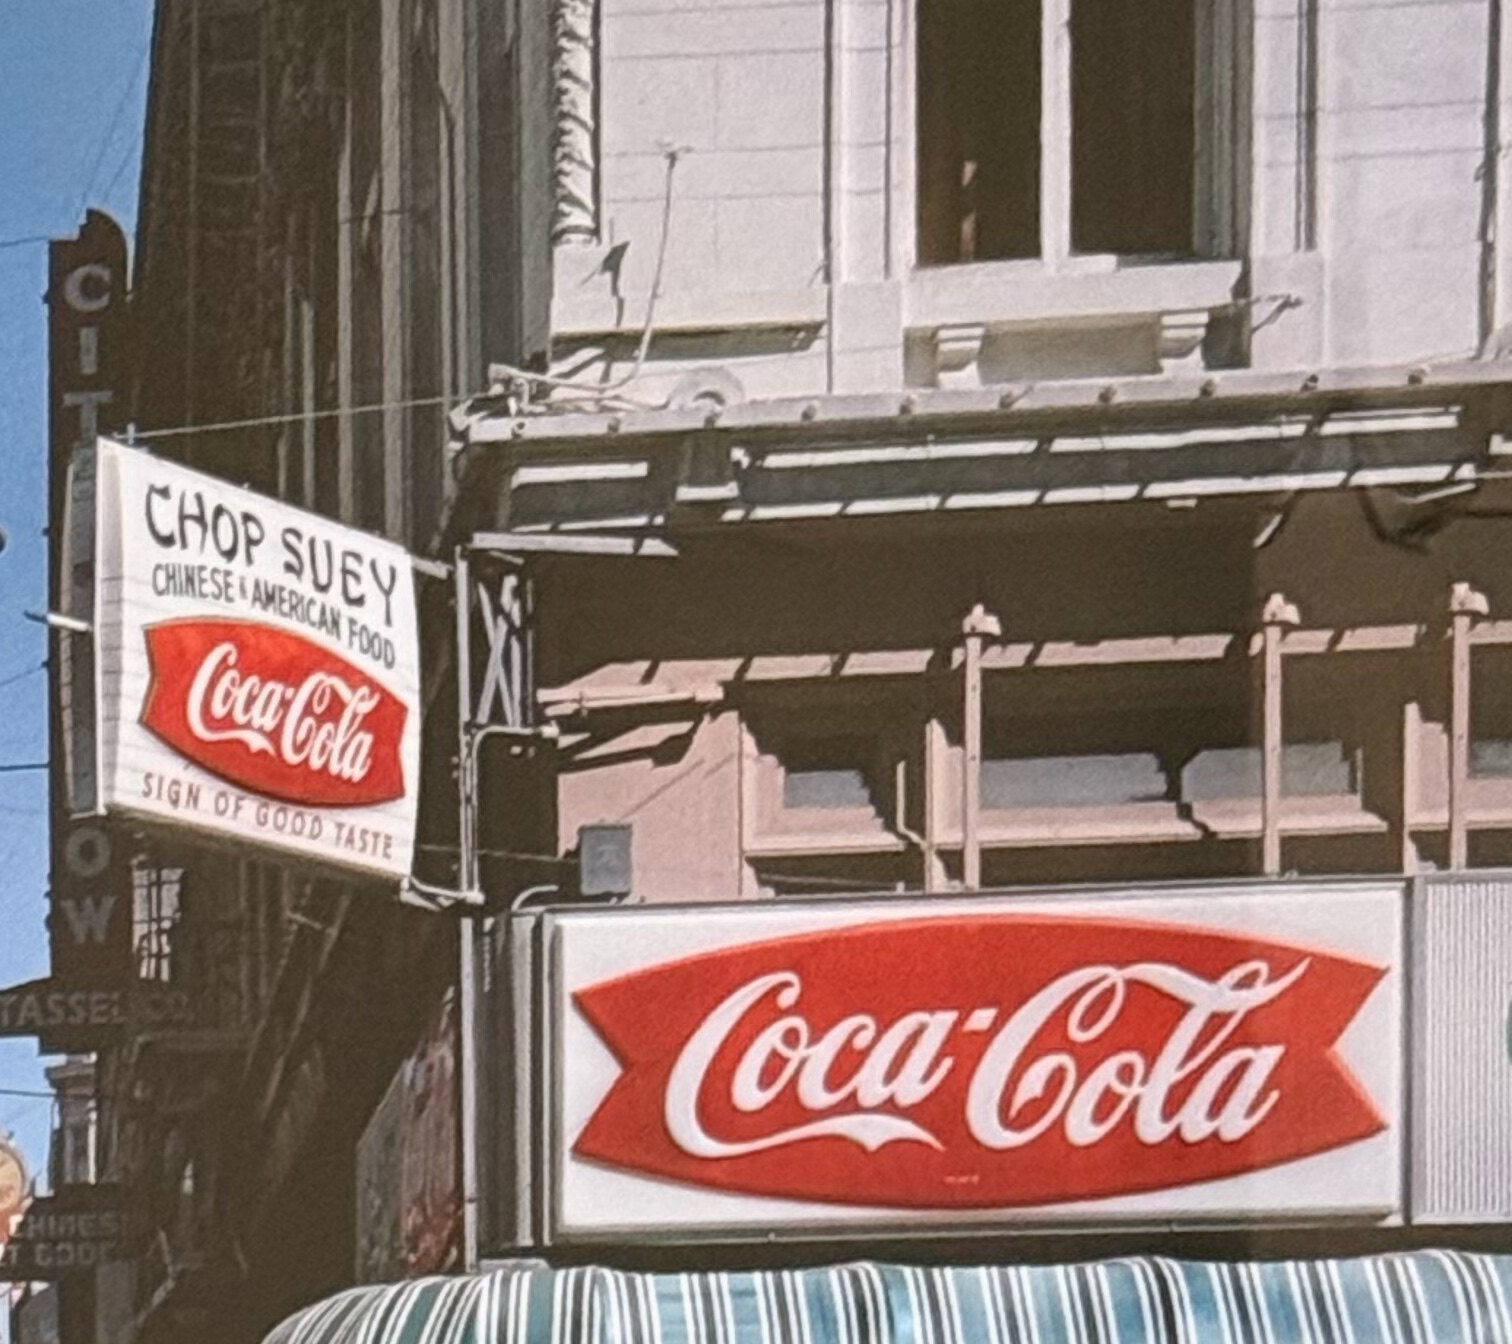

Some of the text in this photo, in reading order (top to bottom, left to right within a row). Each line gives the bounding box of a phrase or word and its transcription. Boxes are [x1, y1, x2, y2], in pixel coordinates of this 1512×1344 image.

[144, 483, 397, 628] CHOP SUEY
[152, 563, 235, 603] CHINESE
[251, 577, 342, 641] AMERICAN
[348, 618, 396, 670] FOOD
[188, 642, 380, 783] Coca-Cola
[141, 772, 393, 860] SIGN OF GOOD TASTE
[664, 956, 1312, 1159] Coca-Cola
